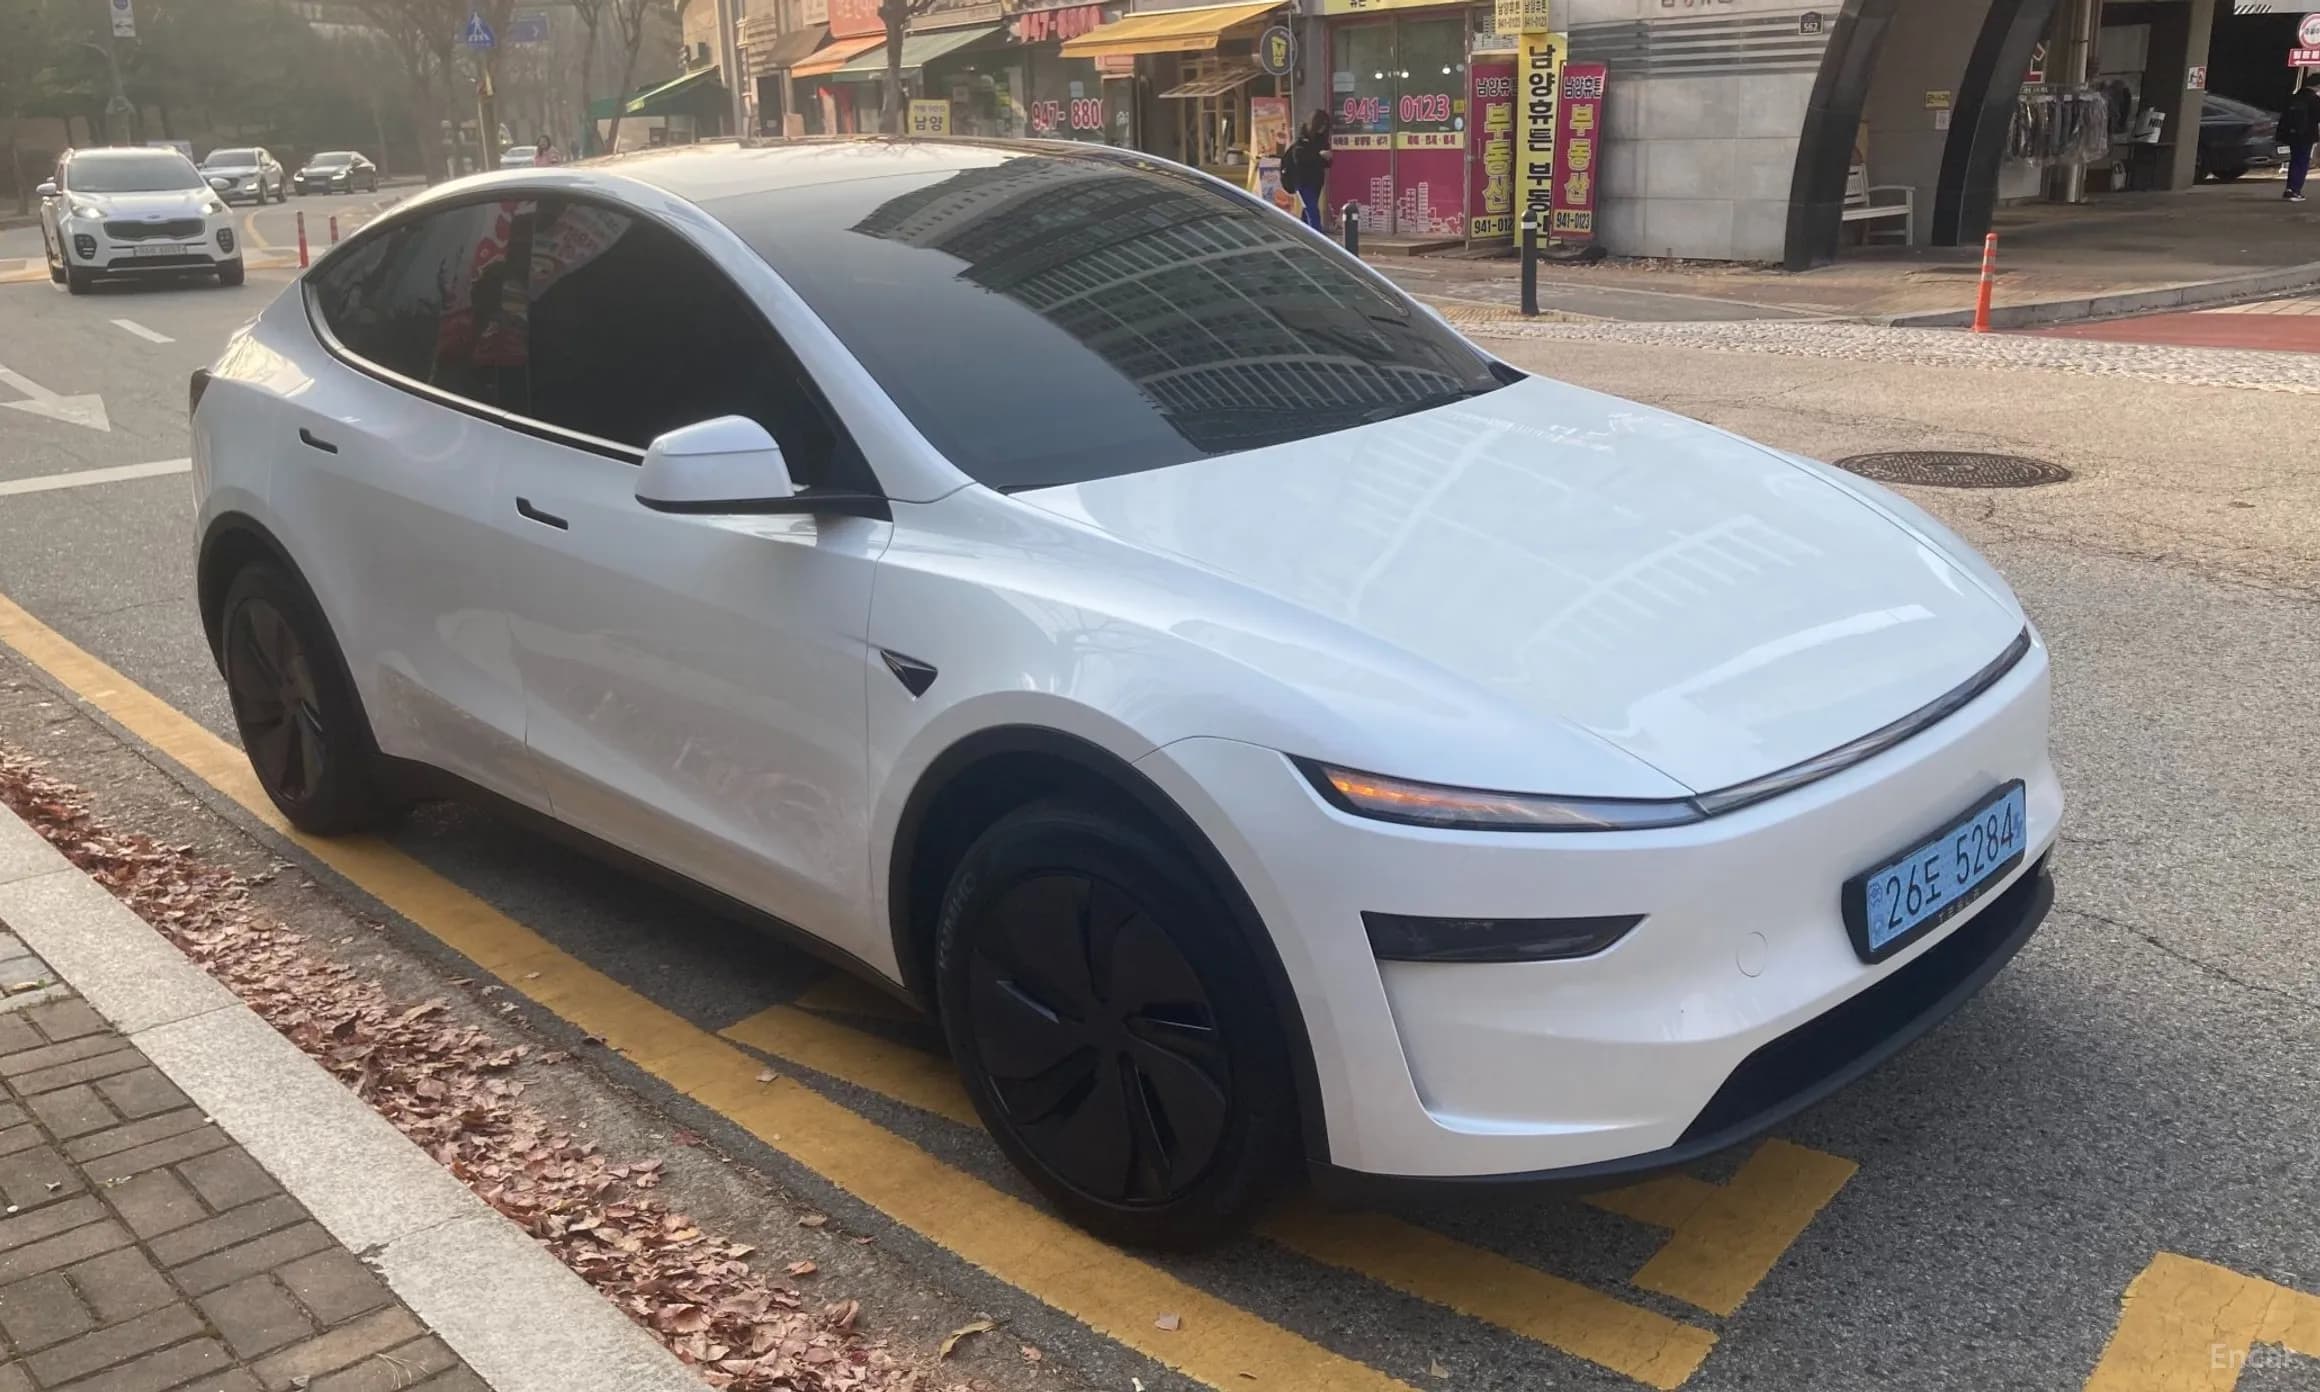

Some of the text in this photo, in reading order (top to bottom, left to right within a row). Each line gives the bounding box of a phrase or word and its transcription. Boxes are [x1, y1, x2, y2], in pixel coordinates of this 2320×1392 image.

[914, 115, 943, 131] 남양
[1528, 44, 1556, 152] 남양휴튼
[1482, 103, 1512, 213] 부동산
[1564, 103, 1593, 205] 부동산
[1556, 211, 1590, 230] 941-0123
[1886, 802, 2014, 930] 26도 5284
